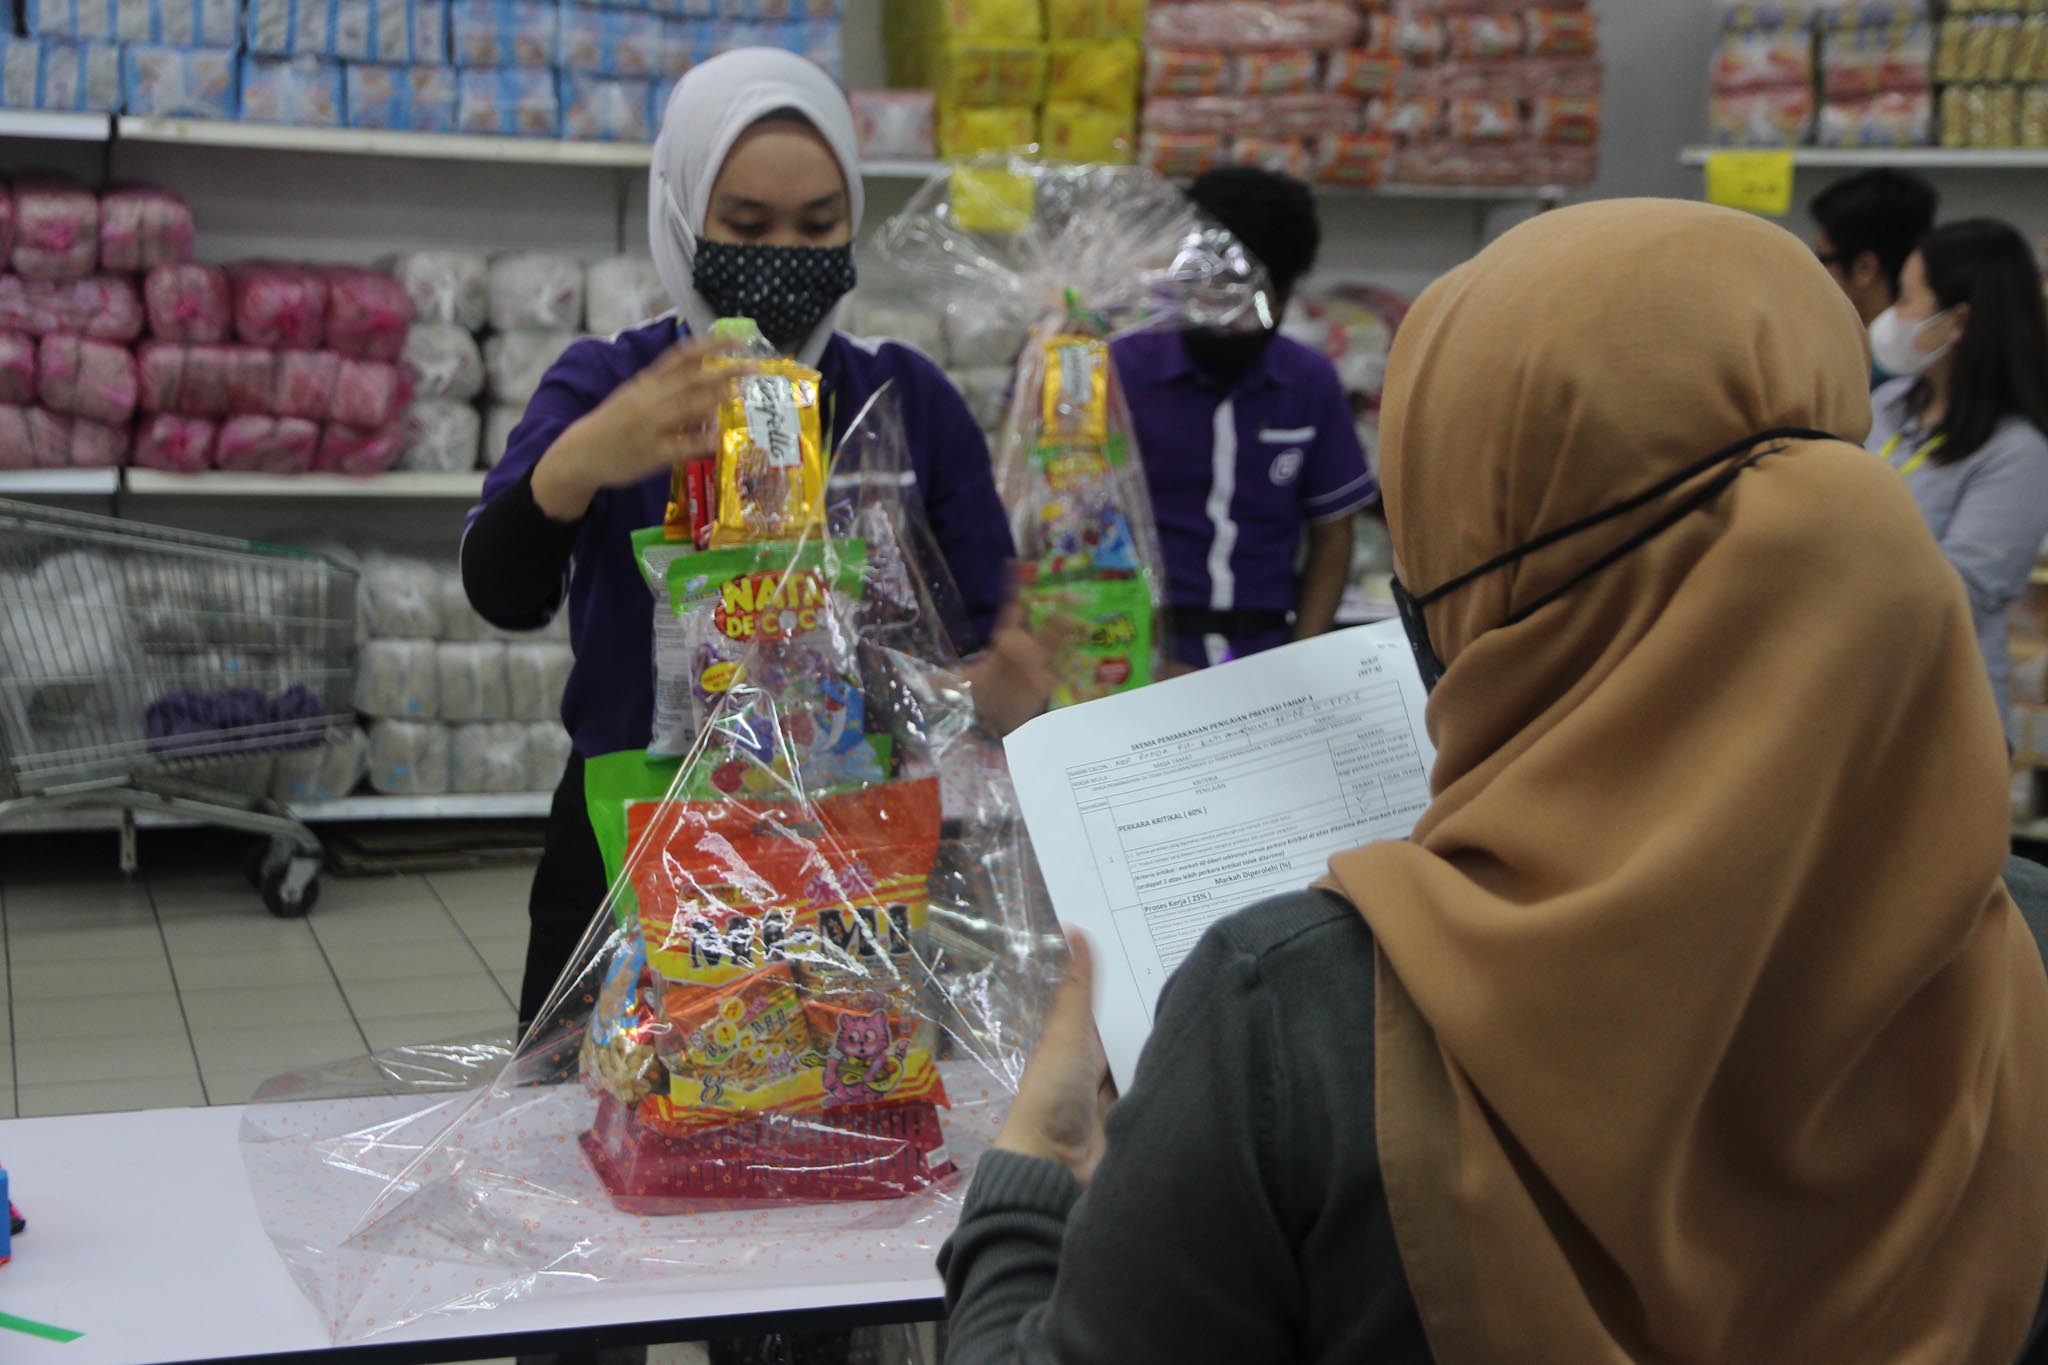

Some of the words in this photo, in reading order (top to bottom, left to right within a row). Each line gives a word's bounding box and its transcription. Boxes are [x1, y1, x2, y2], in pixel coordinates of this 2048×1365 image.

[722, 575, 825, 613] NATA
[727, 614, 755, 639] DE
[1130, 739, 1156, 751] SKEMA
[1156, 724, 1208, 744] PEMARKAHAN
[1208, 713, 1247, 729] PENILAIAN
[1247, 703, 1282, 718] PRESTASI
[1282, 696, 1307, 708] TAHAP
[1118, 818, 1150, 832] PERKARA
[1151, 811, 1183, 825] KRITIKAL
[1187, 806, 1202, 817] 60%
[1167, 875, 1182, 883] atau
[1182, 871, 1197, 880] lebih
[1197, 866, 1220, 877] perkara
[1220, 860, 1241, 870] kritikal
[1241, 857, 1257, 865] tidak
[1214, 872, 1241, 885] Markah
[1242, 863, 1278, 879] Diperolehi
[1278, 860, 1292, 871] (%)
[1143, 901, 1167, 913] Proses
[1167, 896, 1187, 909] Kerja
[1191, 892, 1207, 901] 25%
